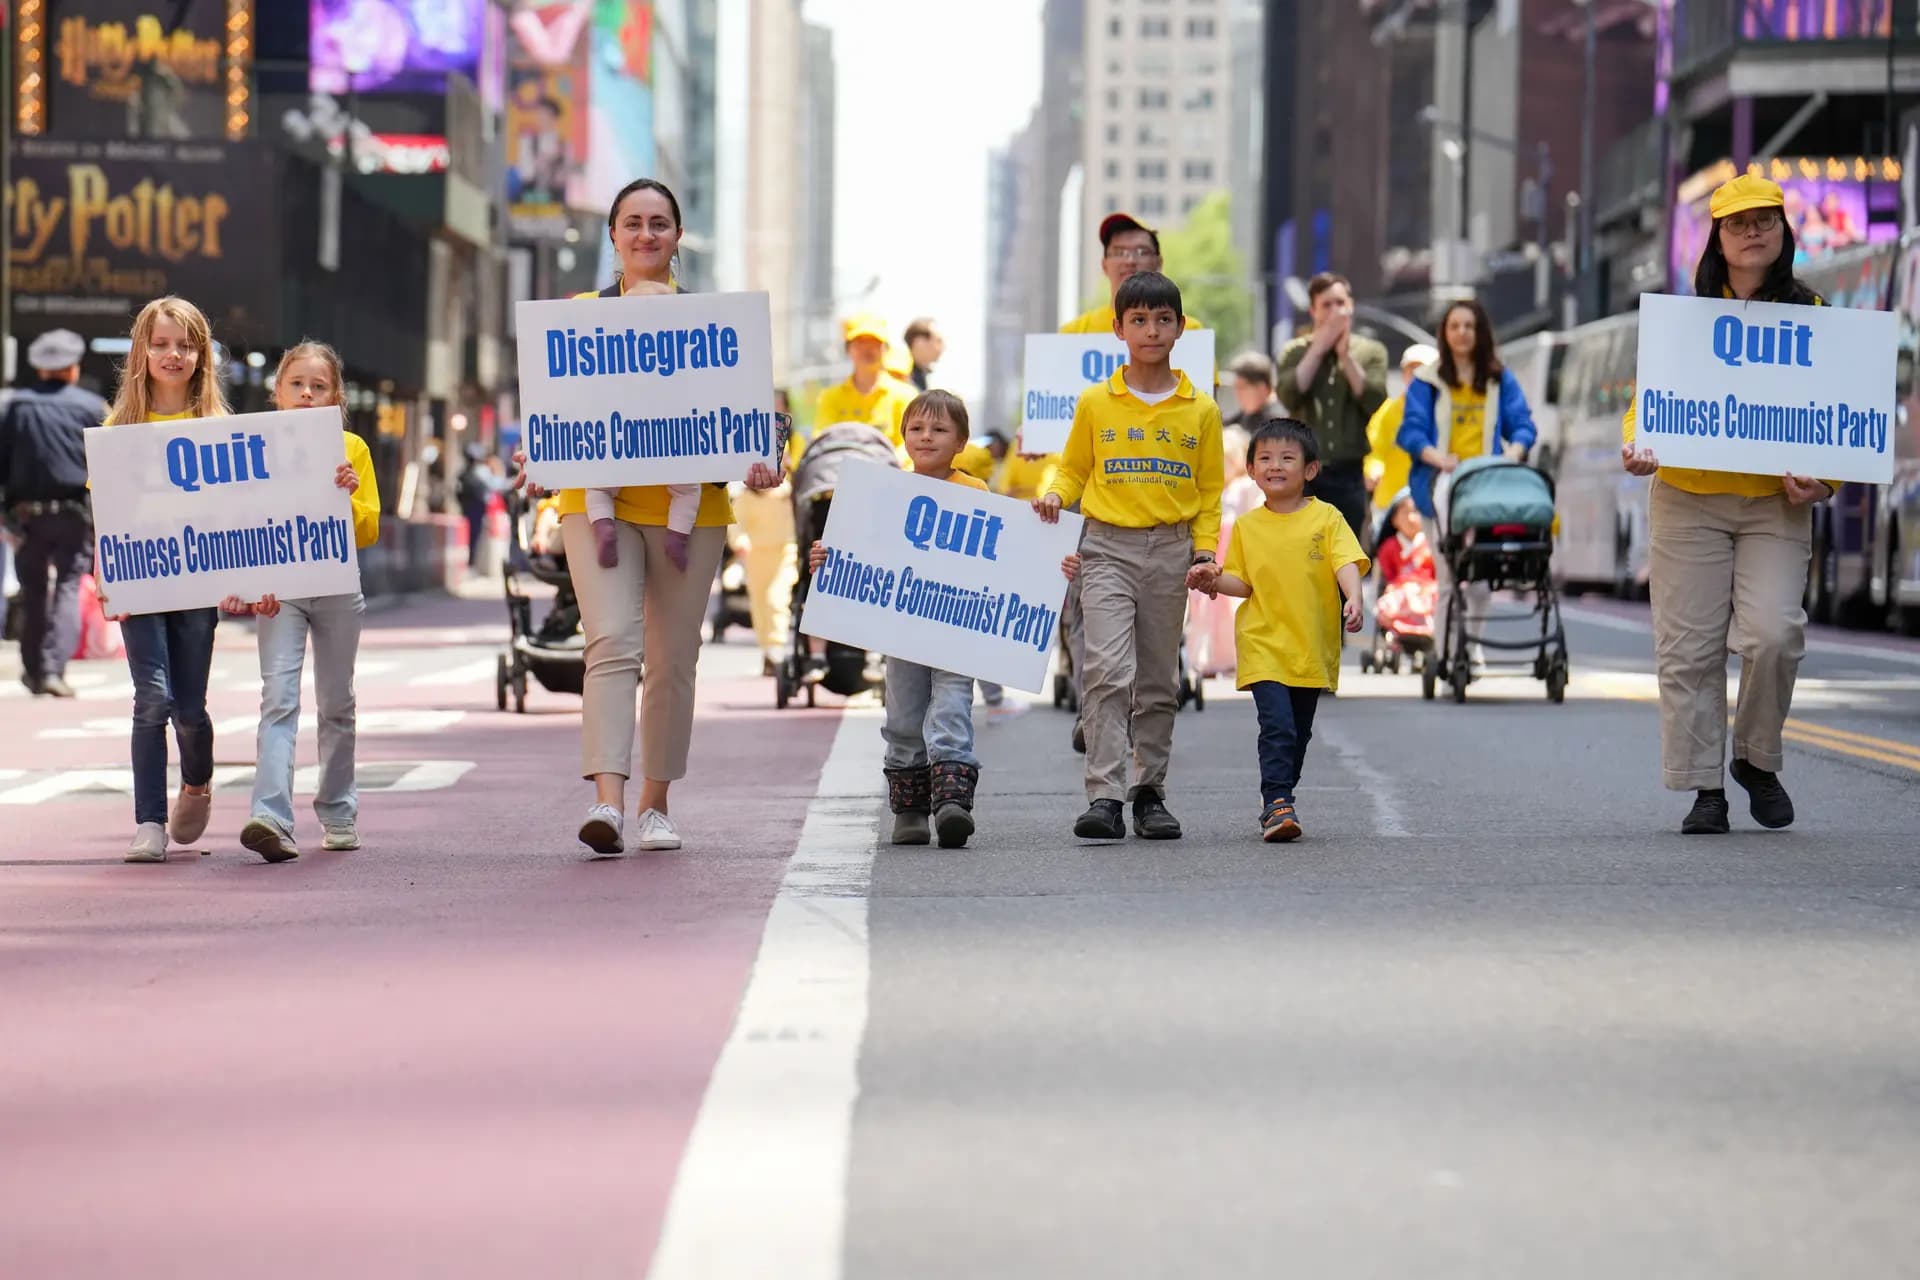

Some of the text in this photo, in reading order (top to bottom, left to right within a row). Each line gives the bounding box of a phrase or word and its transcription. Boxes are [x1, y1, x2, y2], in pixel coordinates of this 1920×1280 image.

[67, 163, 229, 277] Potter
[546, 323, 739, 378] Disintegrate
[1081, 350, 1125, 384] Qu
[1712, 315, 1814, 367] Quit
[1027, 390, 1077, 421] Chines
[1642, 389, 1888, 455] Chinese Communist Party
[167, 432, 270, 493] Quit
[528, 406, 771, 463] Chinese Communist Party
[1100, 425, 1198, 450] 法輪大法
[1106, 460, 1189, 476] FALUN DAFA
[100, 514, 349, 584] Chinese Communist Party
[904, 495, 1004, 561] Quit
[816, 547, 1057, 653] Chinese Communist Party
